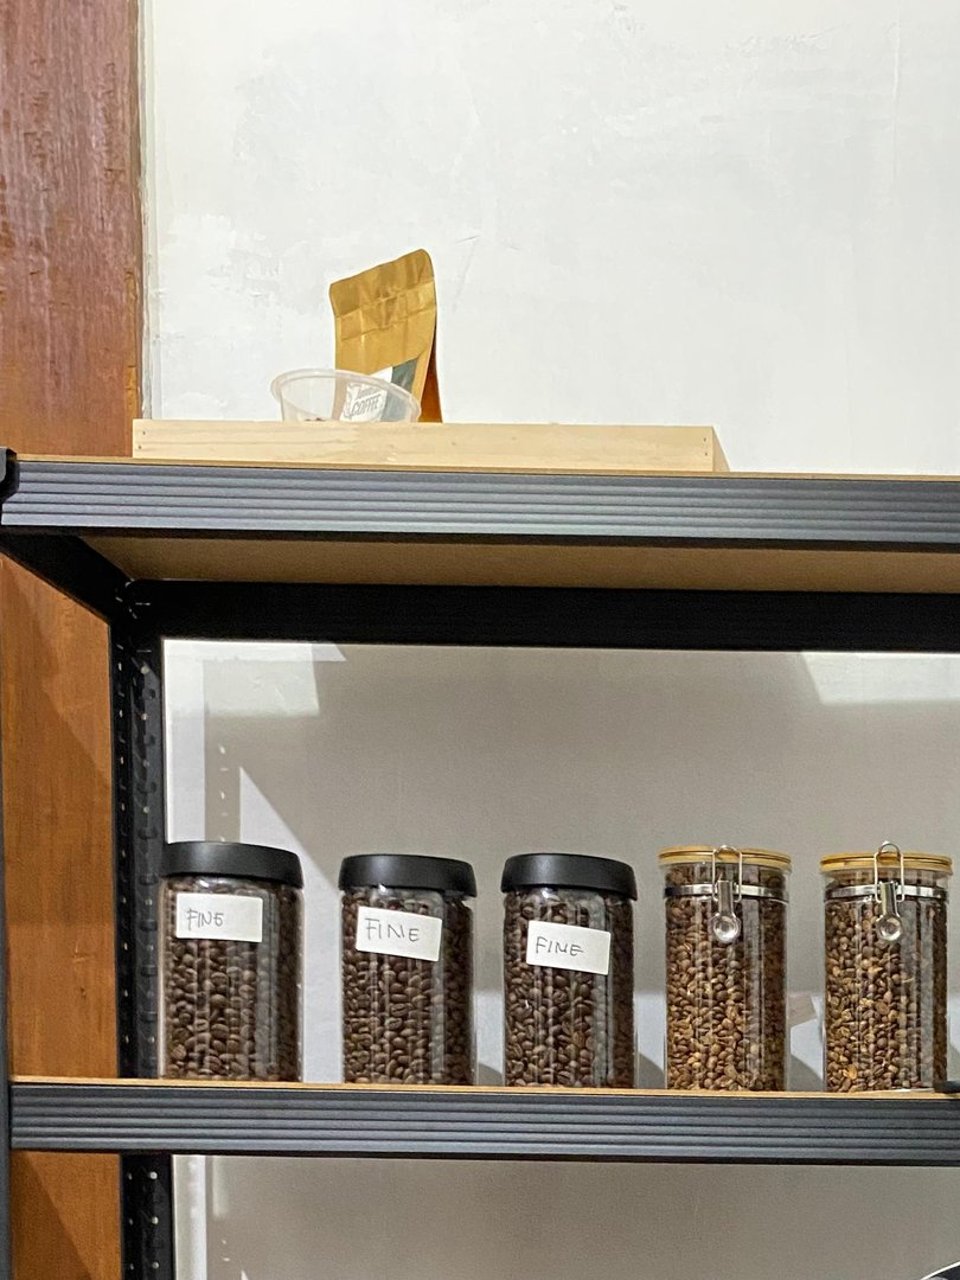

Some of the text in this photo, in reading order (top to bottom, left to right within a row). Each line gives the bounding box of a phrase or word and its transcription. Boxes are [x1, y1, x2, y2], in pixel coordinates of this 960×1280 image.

[186, 908, 224, 931] FINE
[364, 917, 420, 942] FINE
[535, 935, 584, 957] FINE
